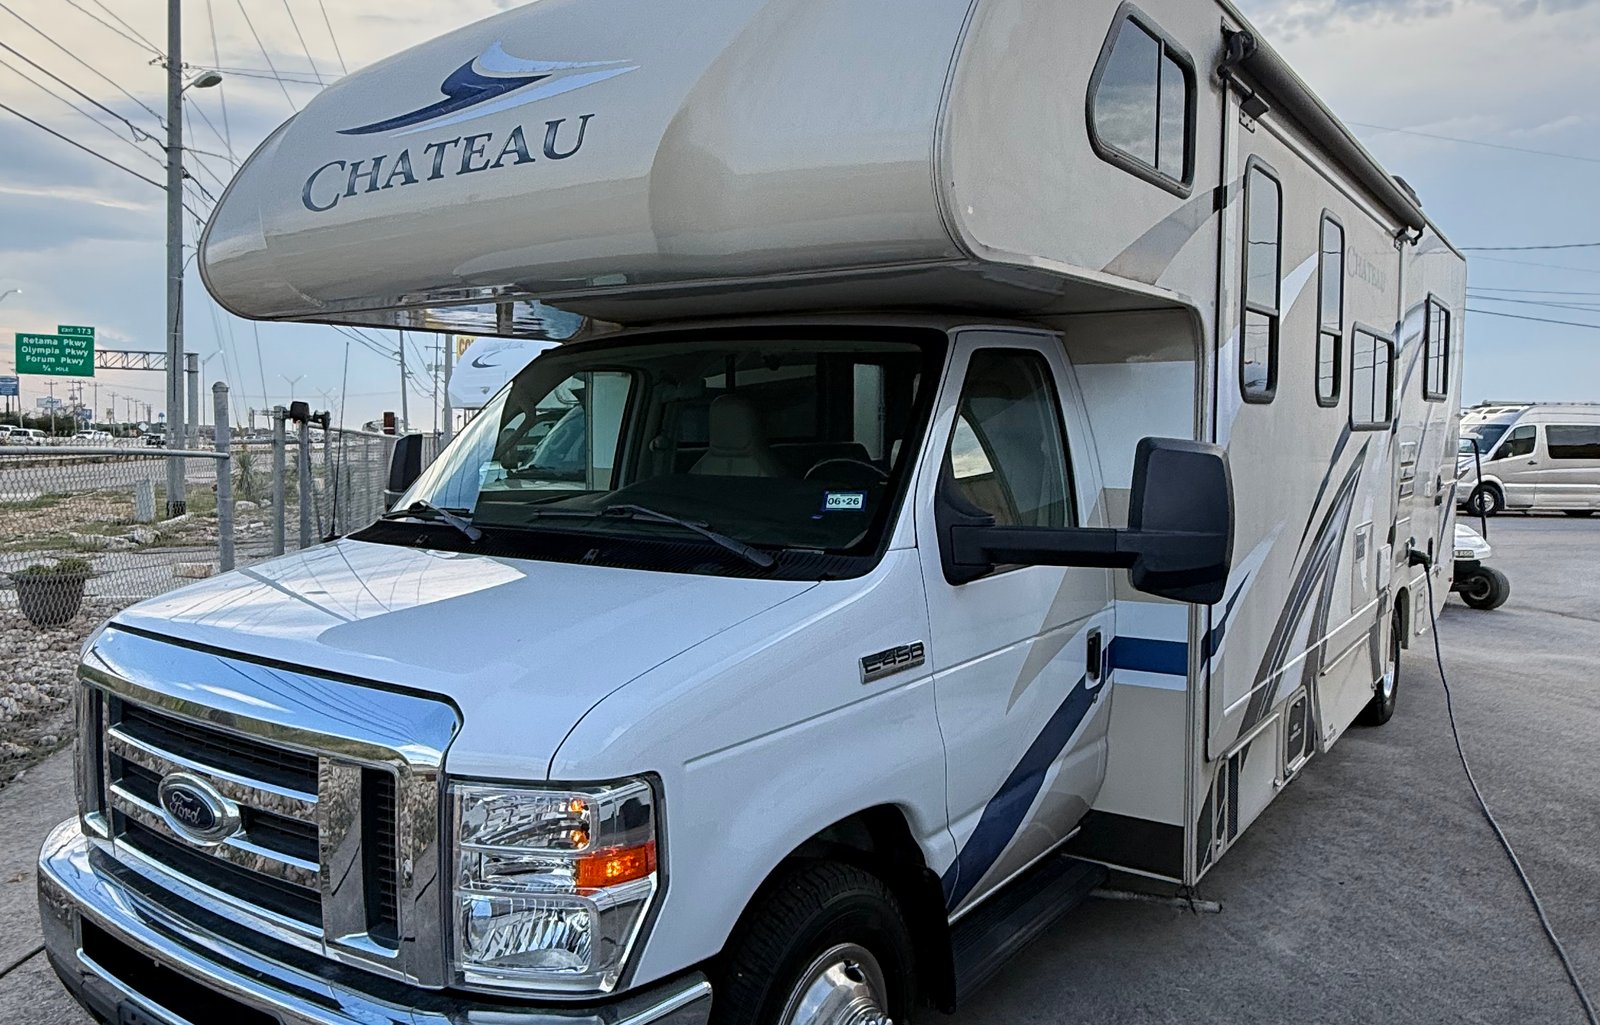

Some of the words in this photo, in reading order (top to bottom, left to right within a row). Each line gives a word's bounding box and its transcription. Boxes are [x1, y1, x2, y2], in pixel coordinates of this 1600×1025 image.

[302, 113, 595, 212] CHATEAU
[77, 327, 92, 335] 173
[23, 337, 58, 346] Retama
[63, 339, 87, 348] Pkwy
[21, 346, 60, 355] Olympia
[65, 348, 89, 357] Pkwy
[26, 355, 55, 363] Forum
[61, 357, 84, 366] Pkwy
[169, 791, 201, 824] Ford
